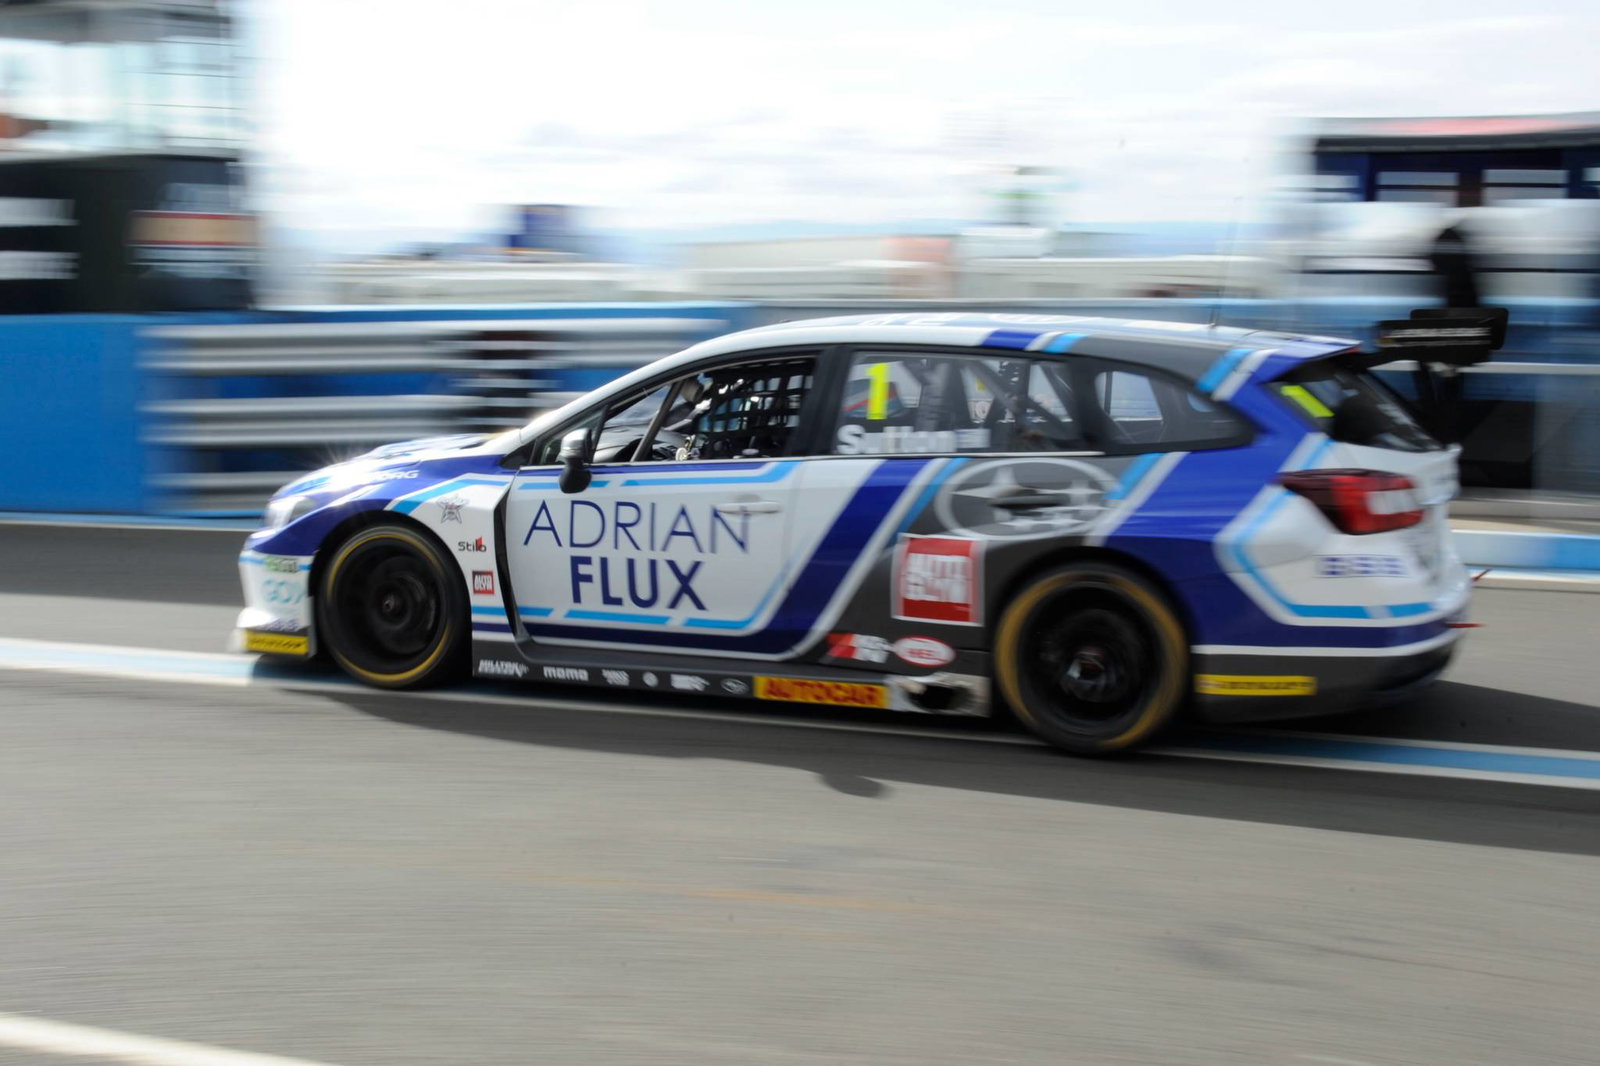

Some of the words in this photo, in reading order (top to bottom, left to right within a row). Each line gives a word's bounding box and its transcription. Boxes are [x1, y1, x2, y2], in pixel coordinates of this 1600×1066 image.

[866, 363, 891, 420] 1
[458, 537, 487, 552] Stilo
[523, 499, 749, 554] ADRIAN
[570, 555, 708, 611] FLUX
[765, 677, 882, 707] AUTOCAR
